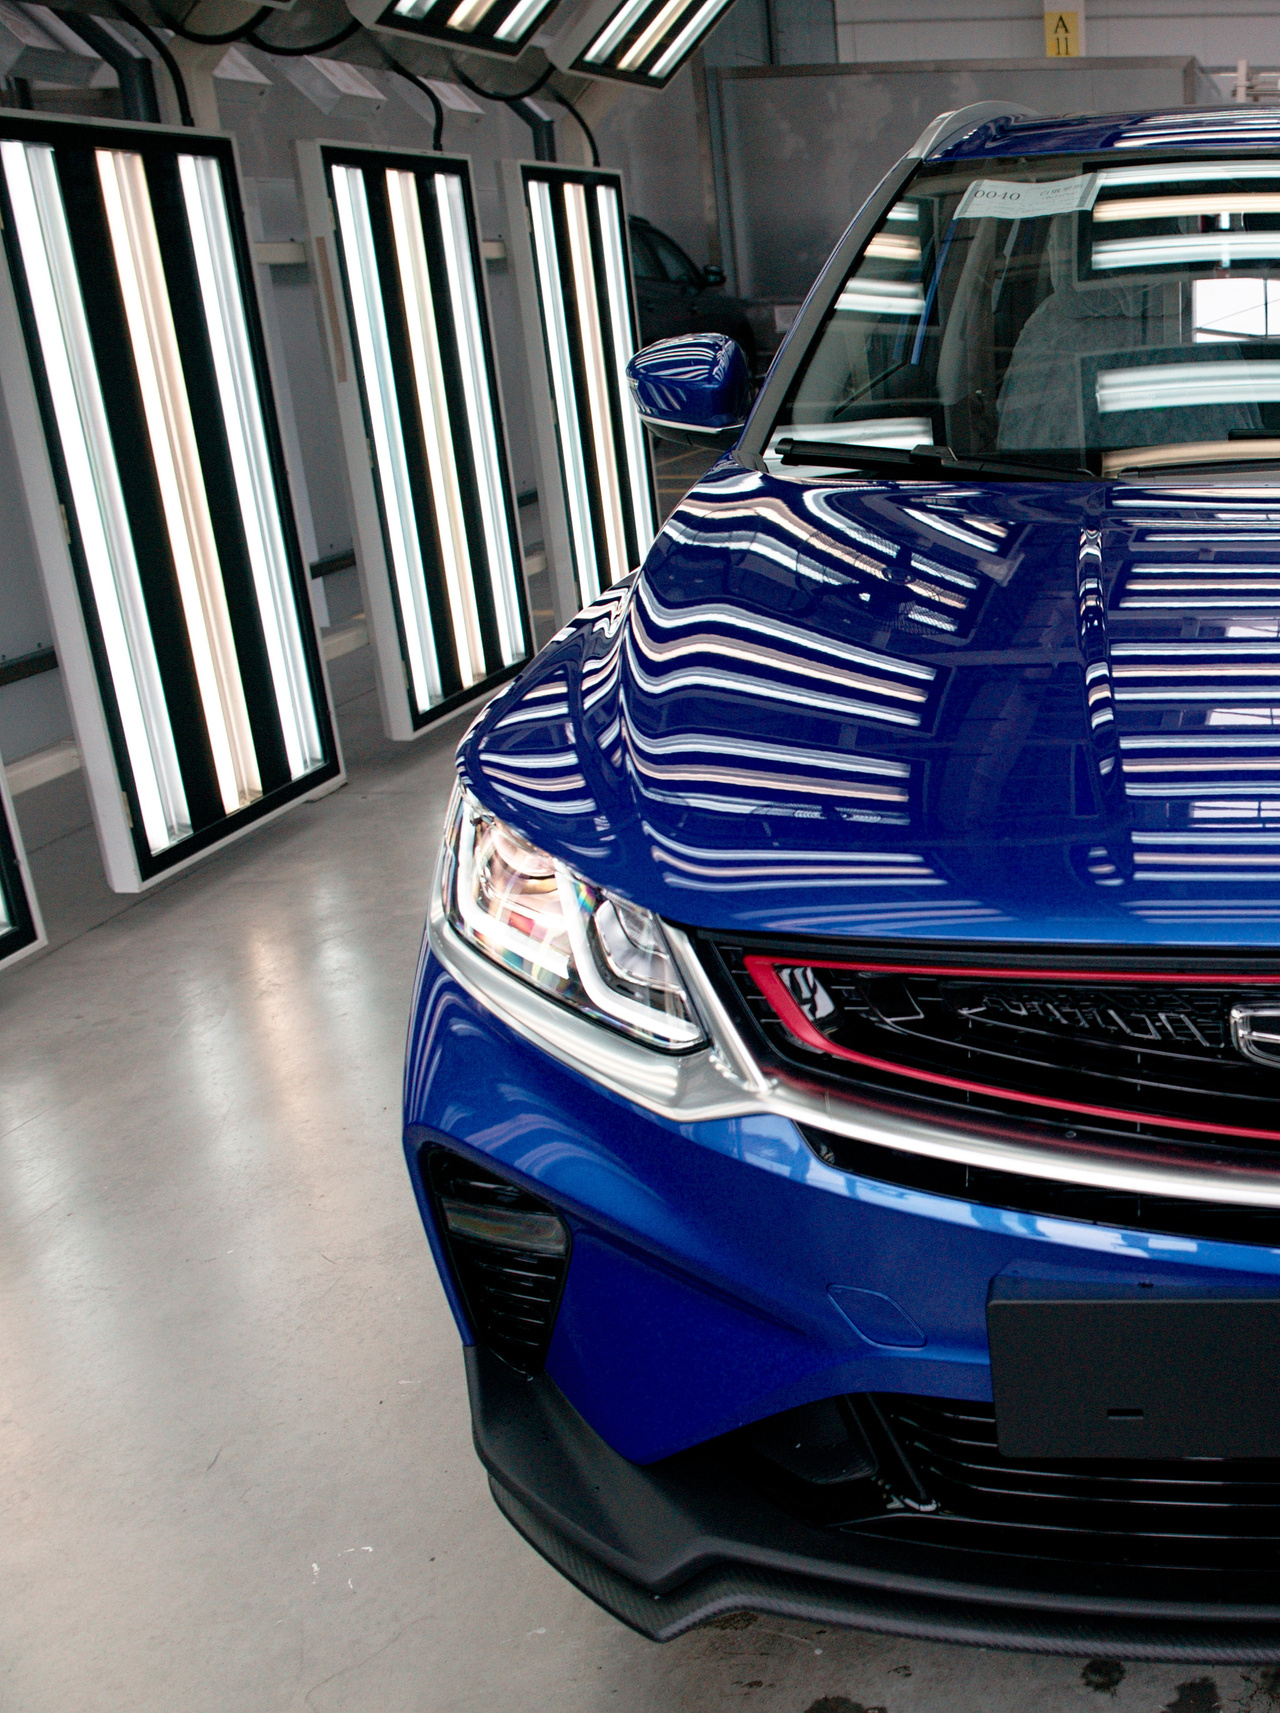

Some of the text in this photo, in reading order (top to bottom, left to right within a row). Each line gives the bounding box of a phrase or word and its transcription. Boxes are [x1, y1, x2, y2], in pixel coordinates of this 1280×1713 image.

[1054, 15, 1070, 33] A
[1056, 37, 1070, 55] 11
[974, 189, 1021, 201] 0040
